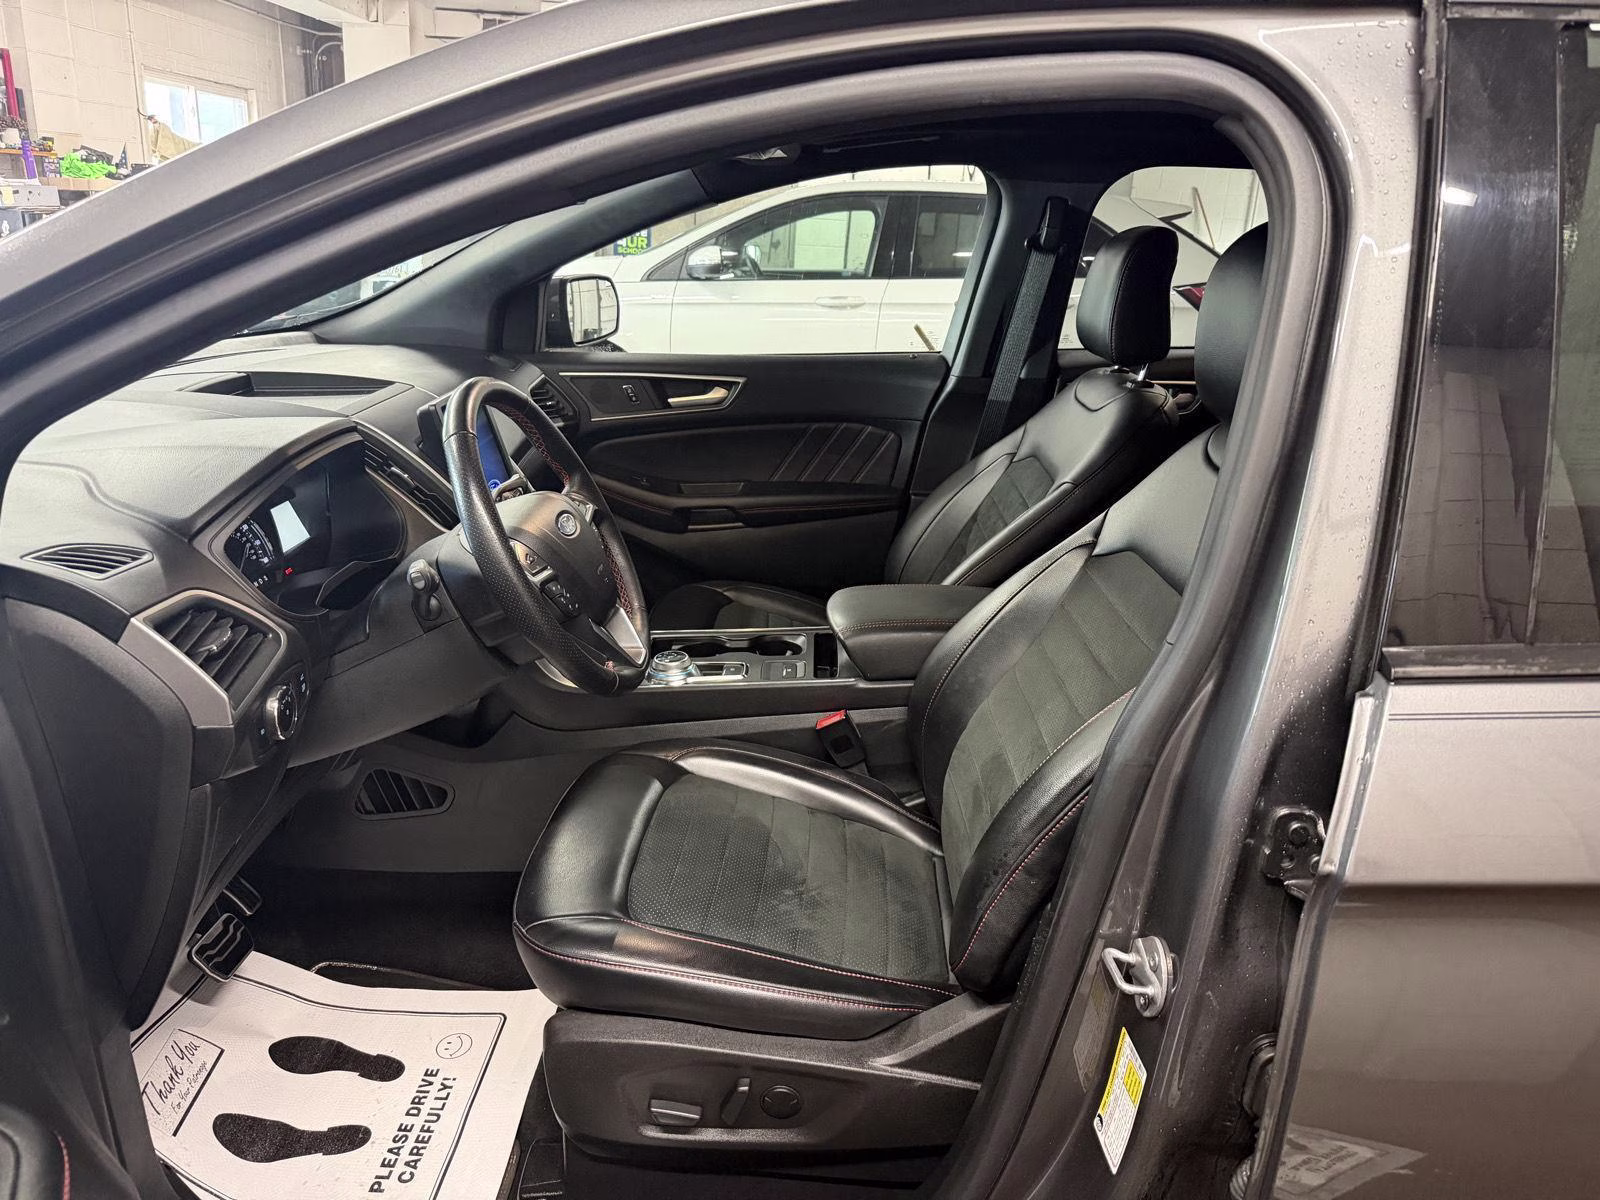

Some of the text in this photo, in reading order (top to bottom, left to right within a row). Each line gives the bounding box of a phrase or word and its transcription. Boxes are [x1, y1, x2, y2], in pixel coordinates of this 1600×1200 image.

[142, 1040, 201, 1115] Thank You
[368, 1068, 441, 1193] PLEASE DRIVE
[397, 1077, 457, 1184] CAREFULLY!
